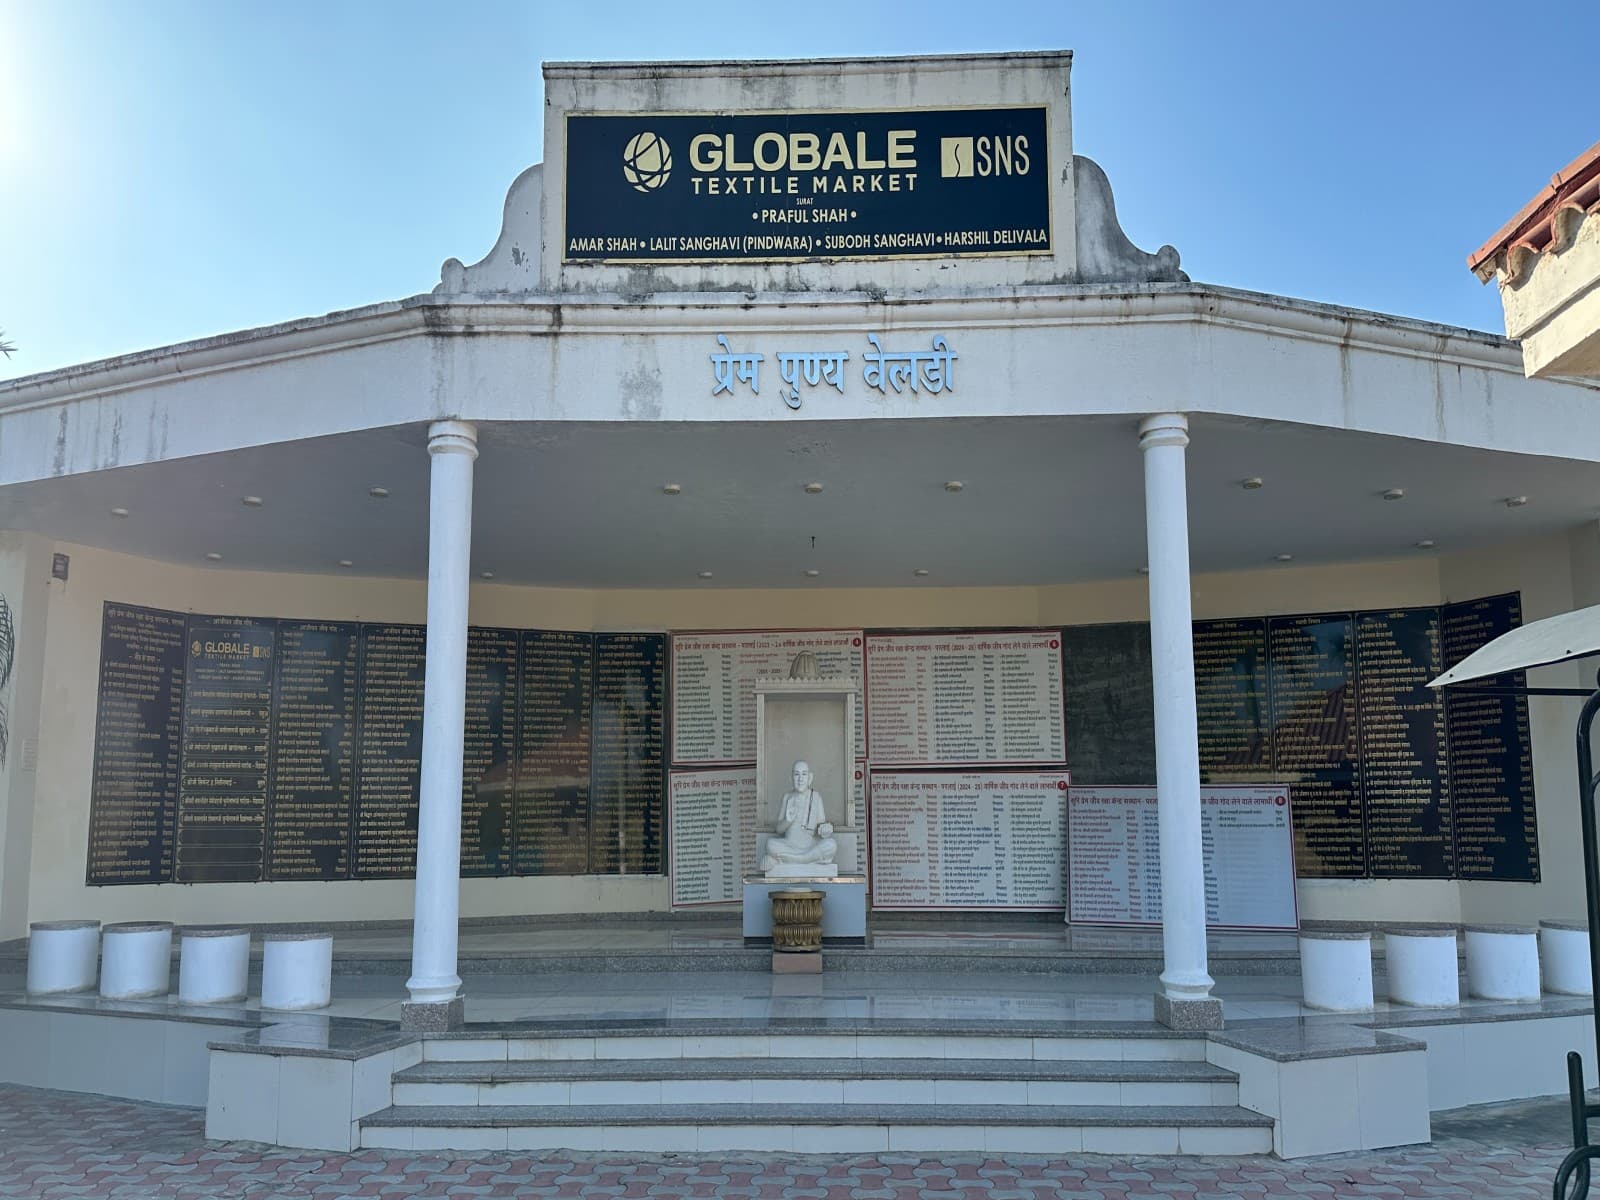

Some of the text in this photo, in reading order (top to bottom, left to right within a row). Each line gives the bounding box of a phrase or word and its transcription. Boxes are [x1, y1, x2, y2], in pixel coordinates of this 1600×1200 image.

[689, 130, 918, 173] GLOBALE
[976, 135, 1030, 177] SNS
[691, 173, 918, 195] TEXTILE MARKET
[796, 198, 813, 206] SURAT
[761, 208, 848, 224] PRAFUL SHAH
[569, 229, 1047, 253] AMAR SHAH LALIT SANGHAVI (PINDWARA) SUBODH SANGHAVI HARSHIL DELIVALA
[710, 333, 764, 396] प्रेम
[776, 351, 849, 410] पुण्य
[205, 642, 250, 654] GLOBALE
